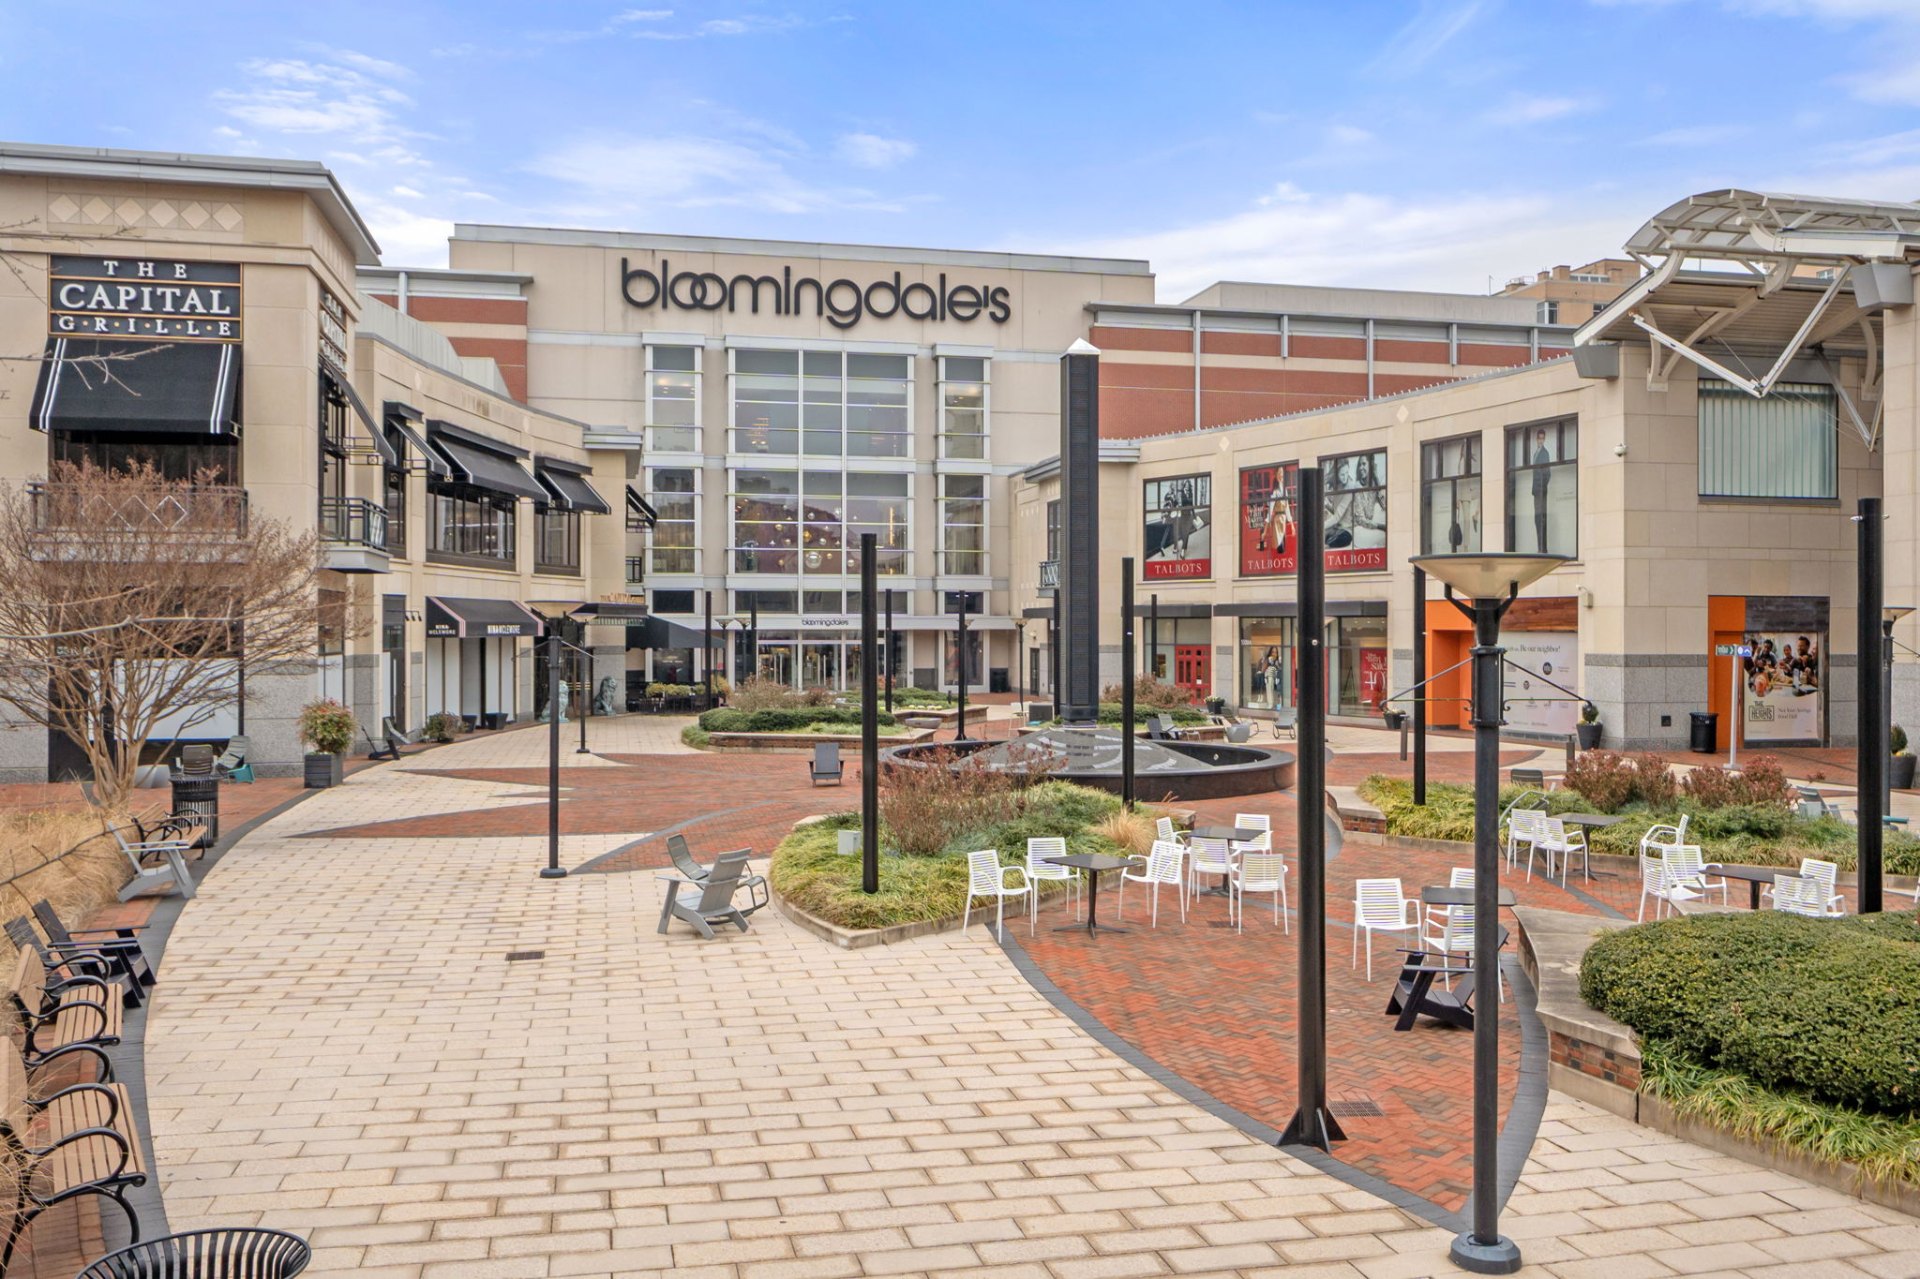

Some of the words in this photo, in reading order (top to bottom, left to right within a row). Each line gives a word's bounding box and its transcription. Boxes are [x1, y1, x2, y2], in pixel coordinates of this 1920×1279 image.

[103, 260, 188, 279] THE
[59, 283, 231, 315] CAPITAL
[621, 257, 1011, 329] bloomingdale's
[1247, 557, 1294, 570] TALBOTS
[1328, 553, 1381, 566] TALBOTS
[1154, 562, 1202, 575] TALBOTS
[1751, 707, 1773, 720] HEIGHTS
